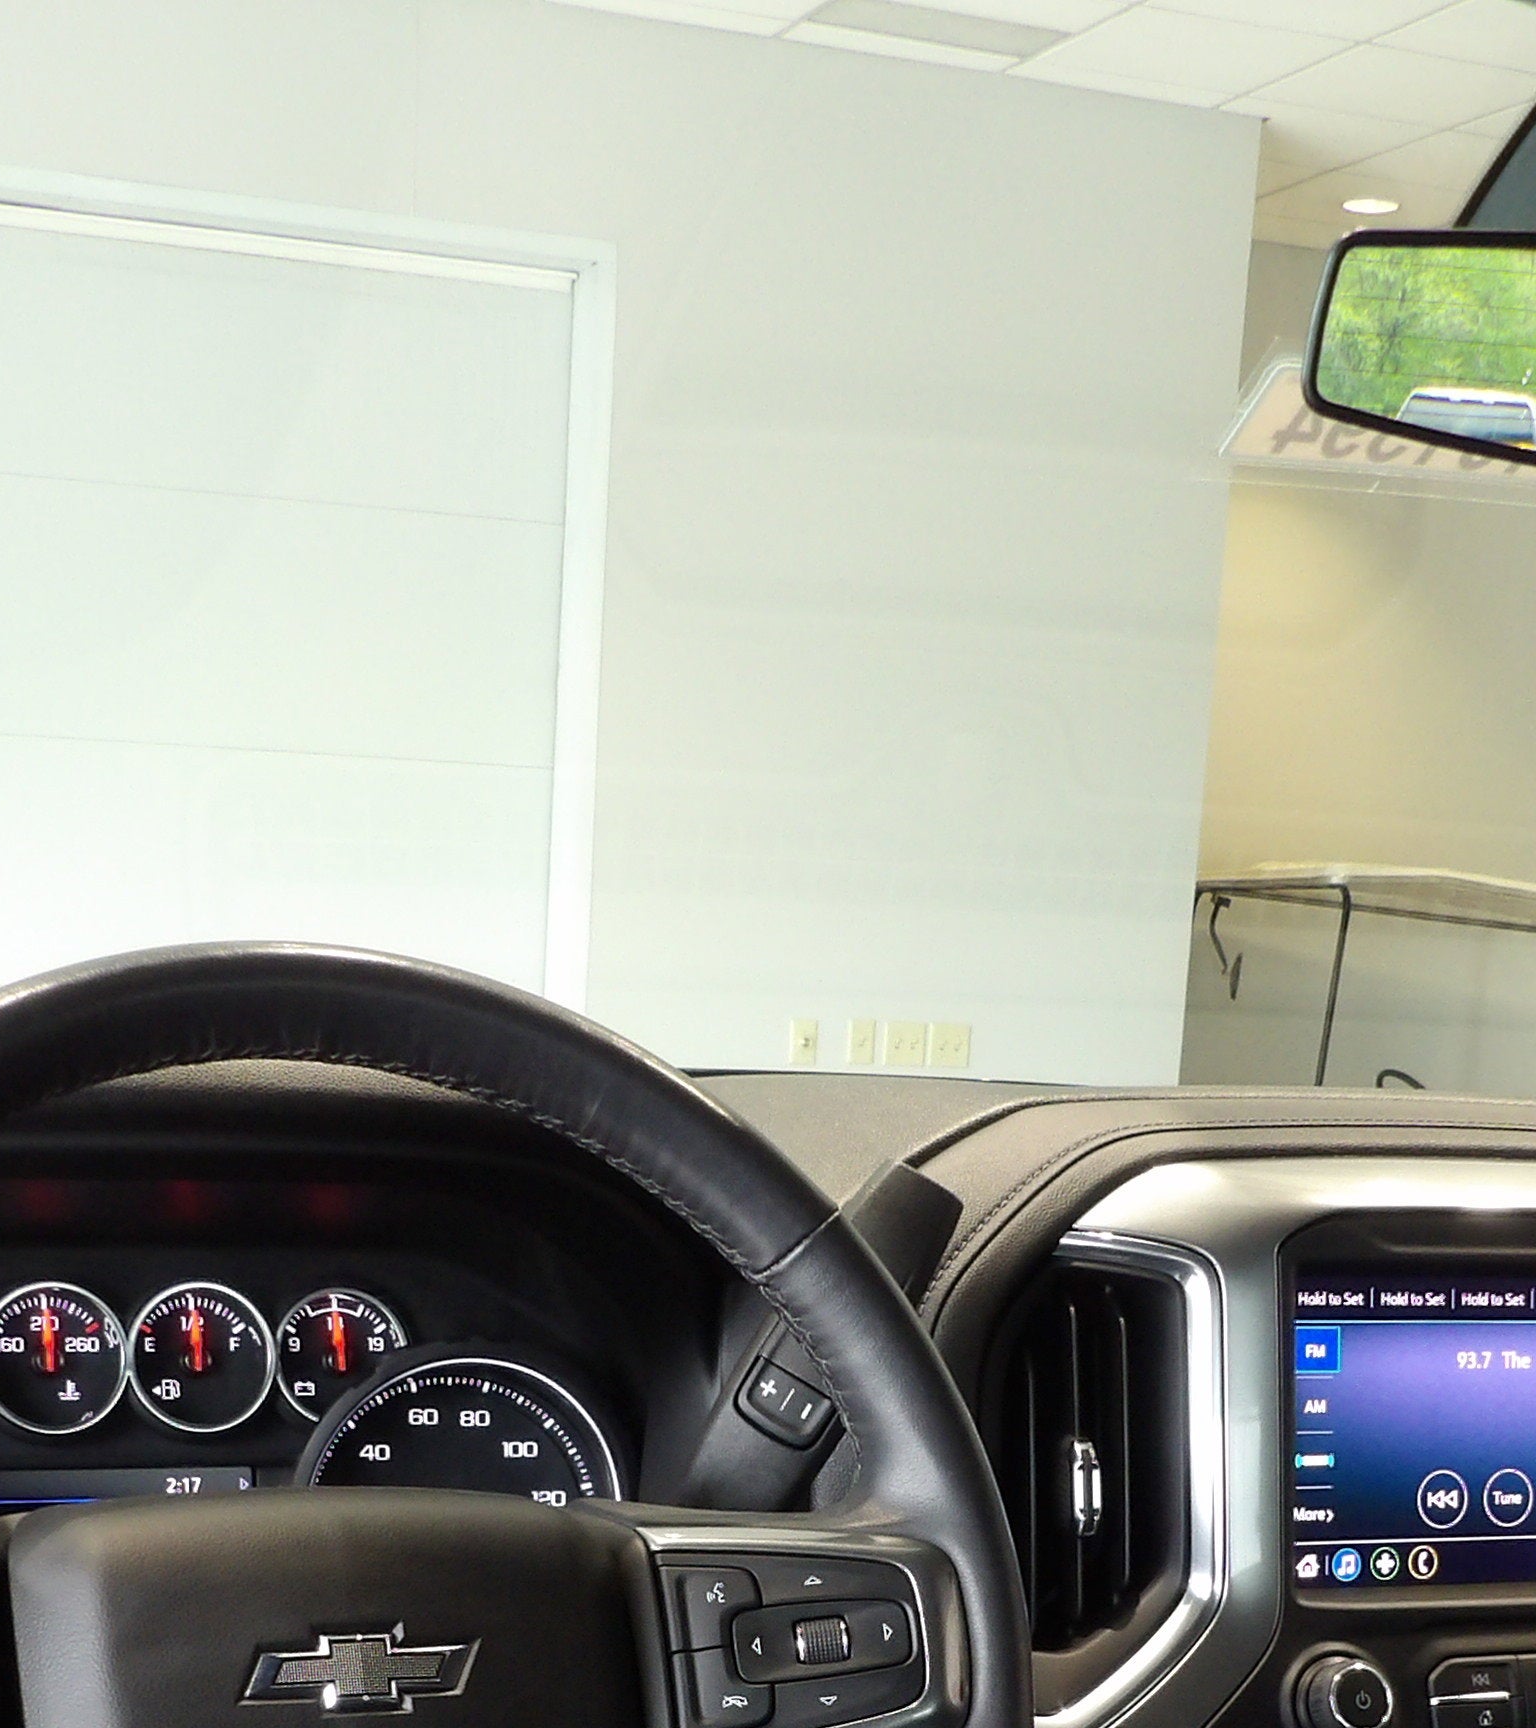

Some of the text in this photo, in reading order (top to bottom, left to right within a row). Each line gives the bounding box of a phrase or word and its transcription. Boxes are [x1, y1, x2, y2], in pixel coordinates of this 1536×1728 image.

[1297, 1291, 1364, 1306] Hold to Set
[1380, 1292, 1446, 1307] Hold to Set
[1461, 1292, 1526, 1307] Hold to Set
[64, 1337, 100, 1353] 260
[144, 1337, 156, 1353] E
[229, 1336, 242, 1352] F
[287, 1336, 300, 1353] 9
[367, 1336, 385, 1353] 19
[1305, 1344, 1326, 1358] FM
[1456, 1351, 1532, 1369] 93.7 The
[1304, 1400, 1327, 1414] AM
[407, 1408, 439, 1425] 60
[459, 1410, 491, 1427] 80
[359, 1444, 391, 1461] 40
[501, 1441, 539, 1458] 100
[165, 1477, 202, 1494] 2:17
[1492, 1491, 1523, 1505] Tune
[1293, 1507, 1326, 1521] More
